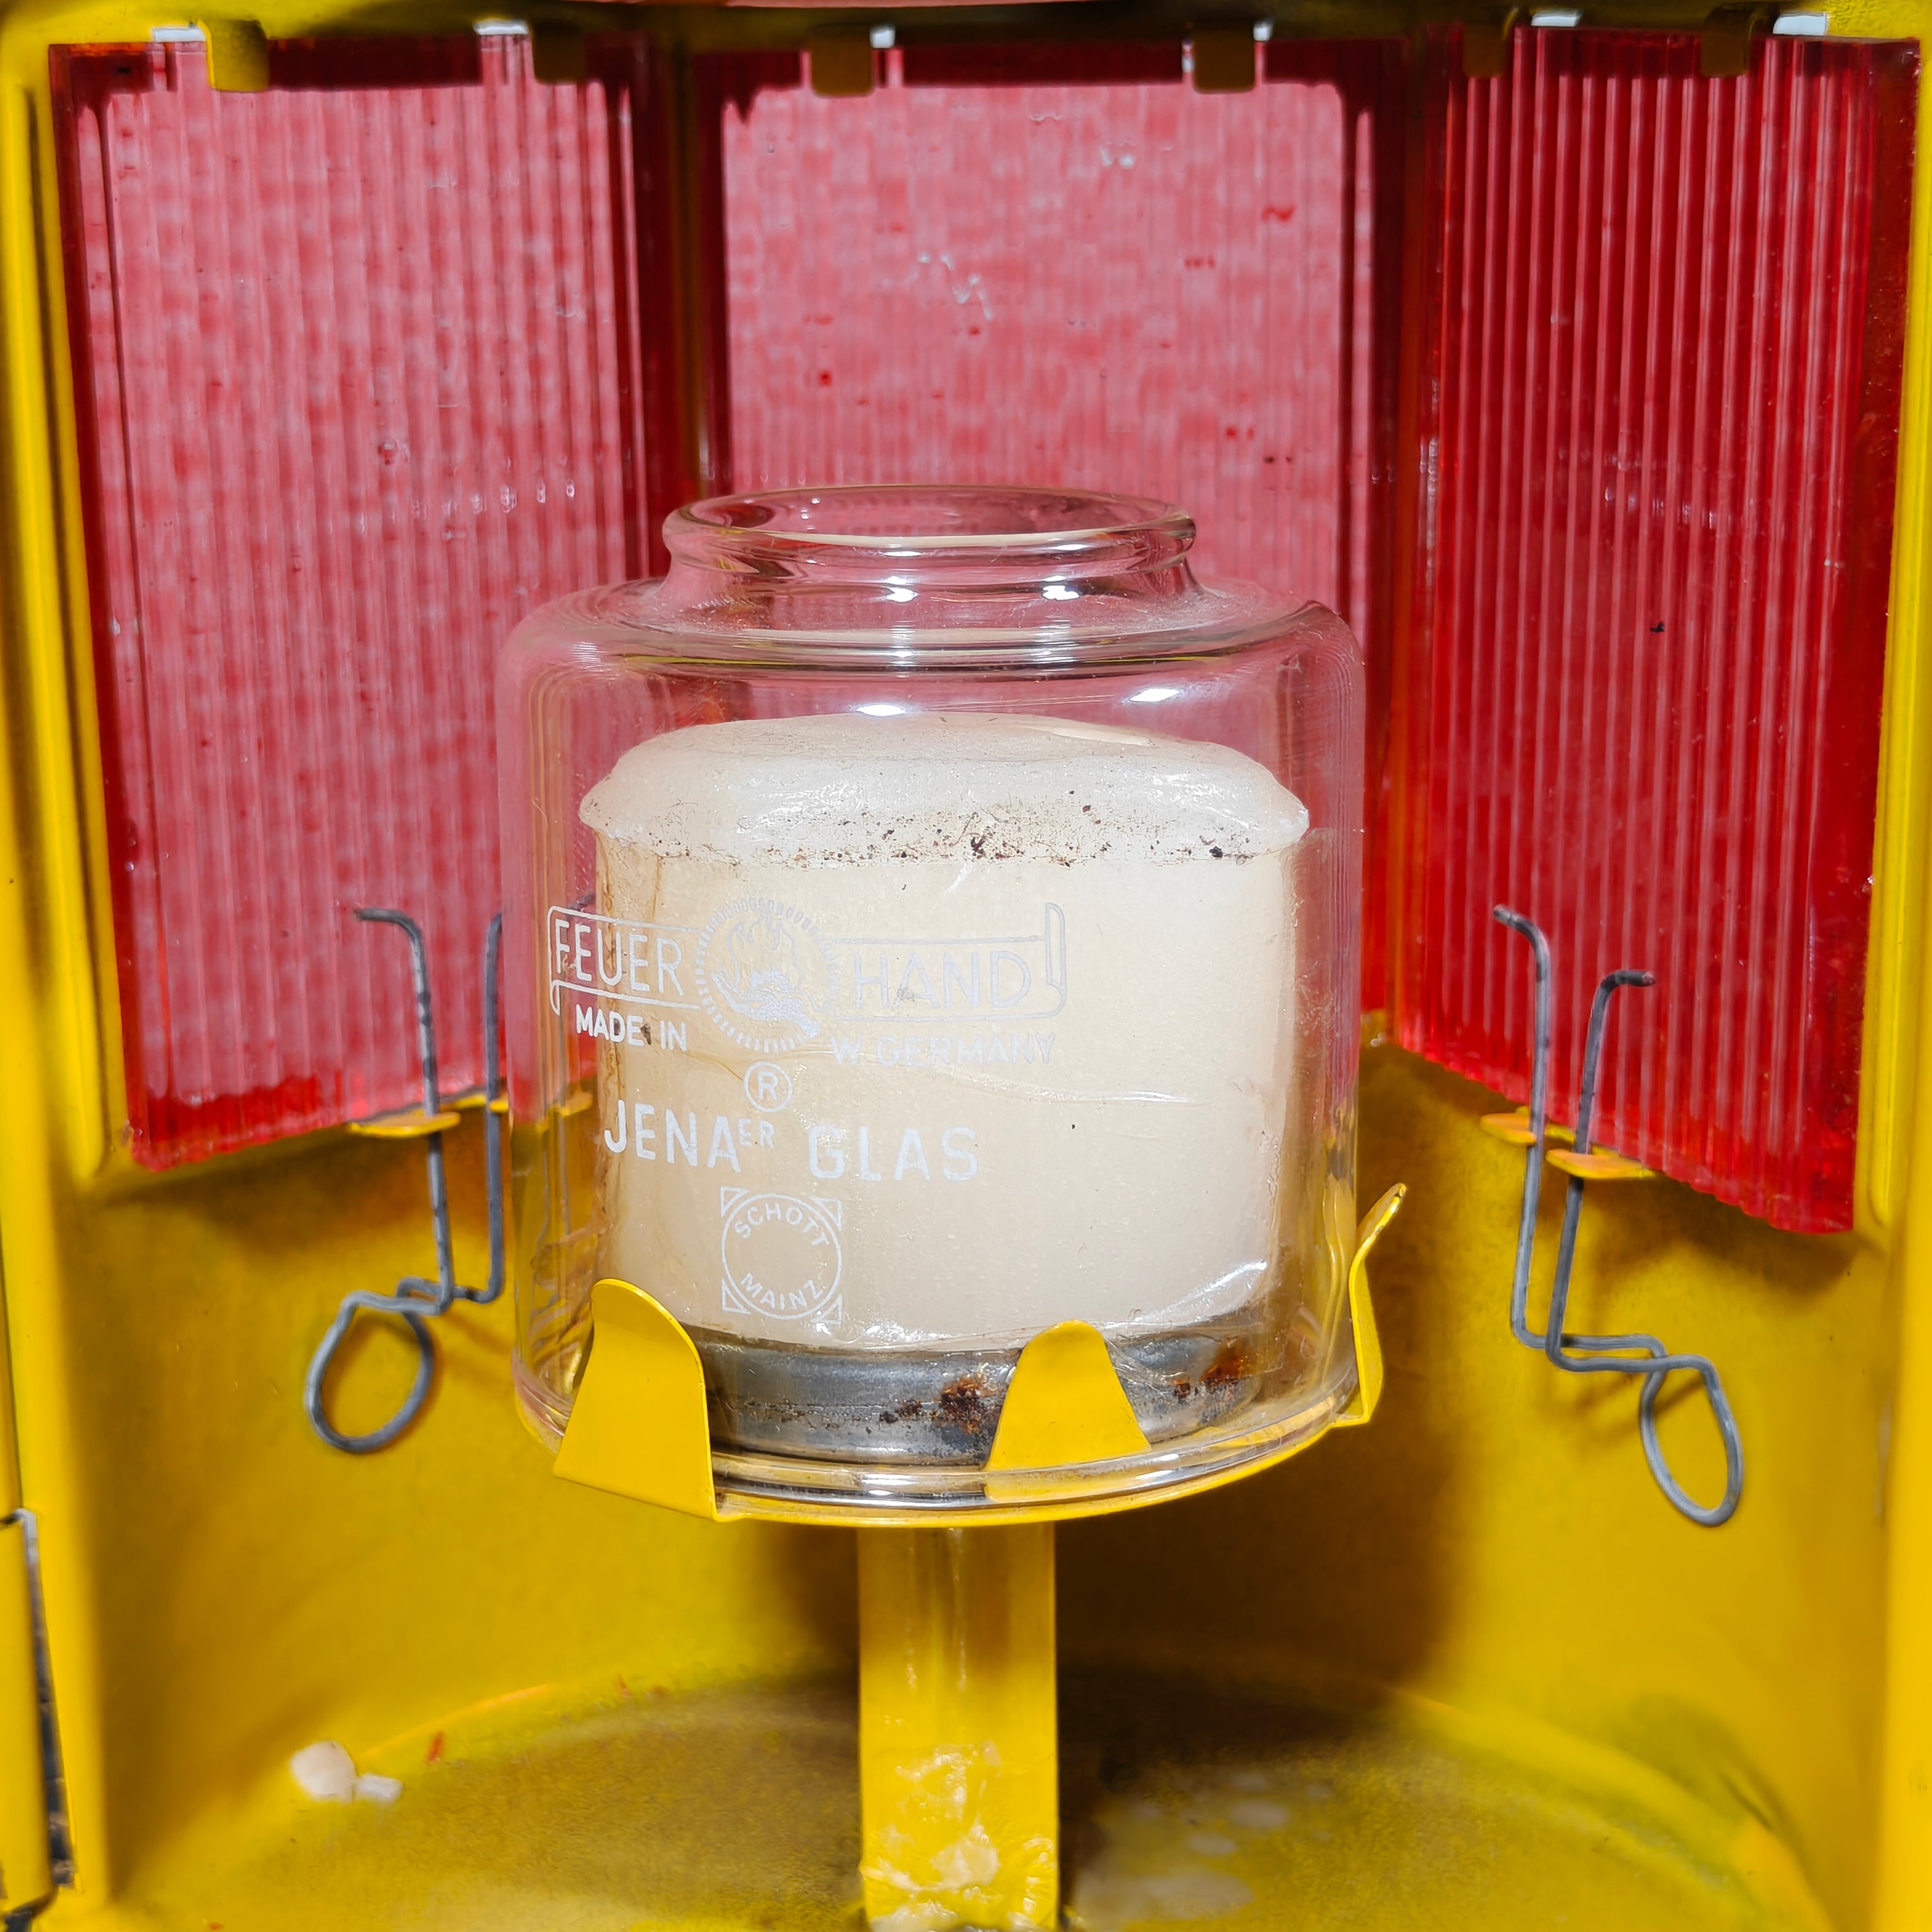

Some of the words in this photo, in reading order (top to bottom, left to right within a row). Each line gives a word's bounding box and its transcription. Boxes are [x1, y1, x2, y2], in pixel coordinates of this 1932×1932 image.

[554, 918, 685, 996] FEUER
[853, 950, 1032, 1010] HAND
[575, 1003, 645, 1047] MADE
[658, 1019, 688, 1052] IN
[875, 1031, 1056, 1068] GERMANY
[808, 1123, 979, 1183] GLAS
[734, 1202, 830, 1246] SCHOTT
[740, 1272, 824, 1311] MAINZ
